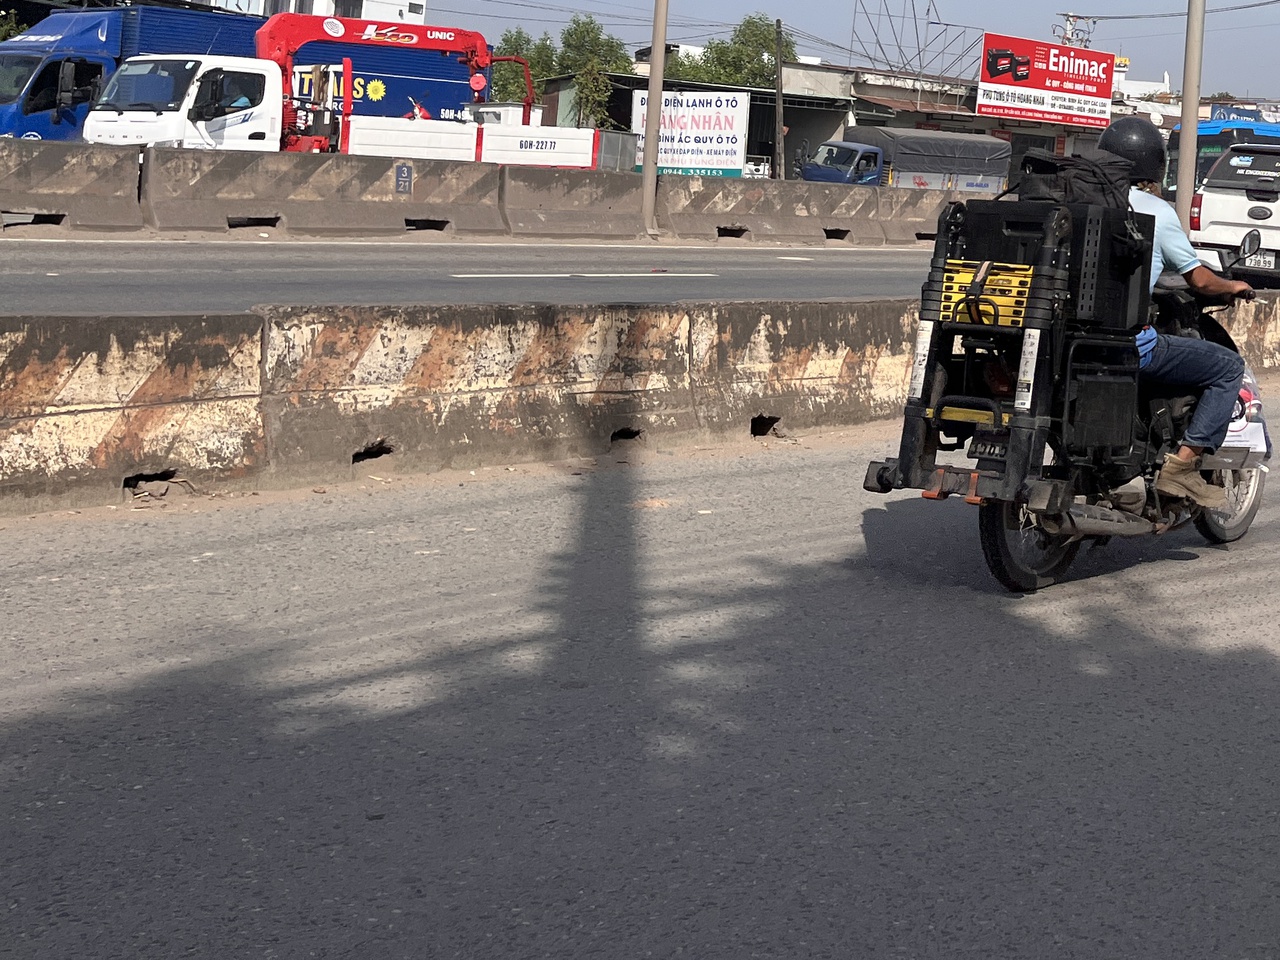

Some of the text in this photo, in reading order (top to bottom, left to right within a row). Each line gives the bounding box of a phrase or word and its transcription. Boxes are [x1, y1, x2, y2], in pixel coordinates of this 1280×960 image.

[427, 30, 455, 40] UNIC
[1049, 48, 1107, 79] Enimac
[686, 99, 712, 110] LẠNH
[715, 97, 723, 108] Ô
[725, 97, 738, 108] TÔ
[641, 111, 734, 130] HÀNG NHÂN
[694, 135, 714, 144] QUY
[716, 135, 724, 144] Ô
[726, 135, 738, 144] TÔ
[402, 167, 408, 177] 3
[1245, 169, 1280, 178] ENGINEERING
[398, 182, 409, 191] 21
